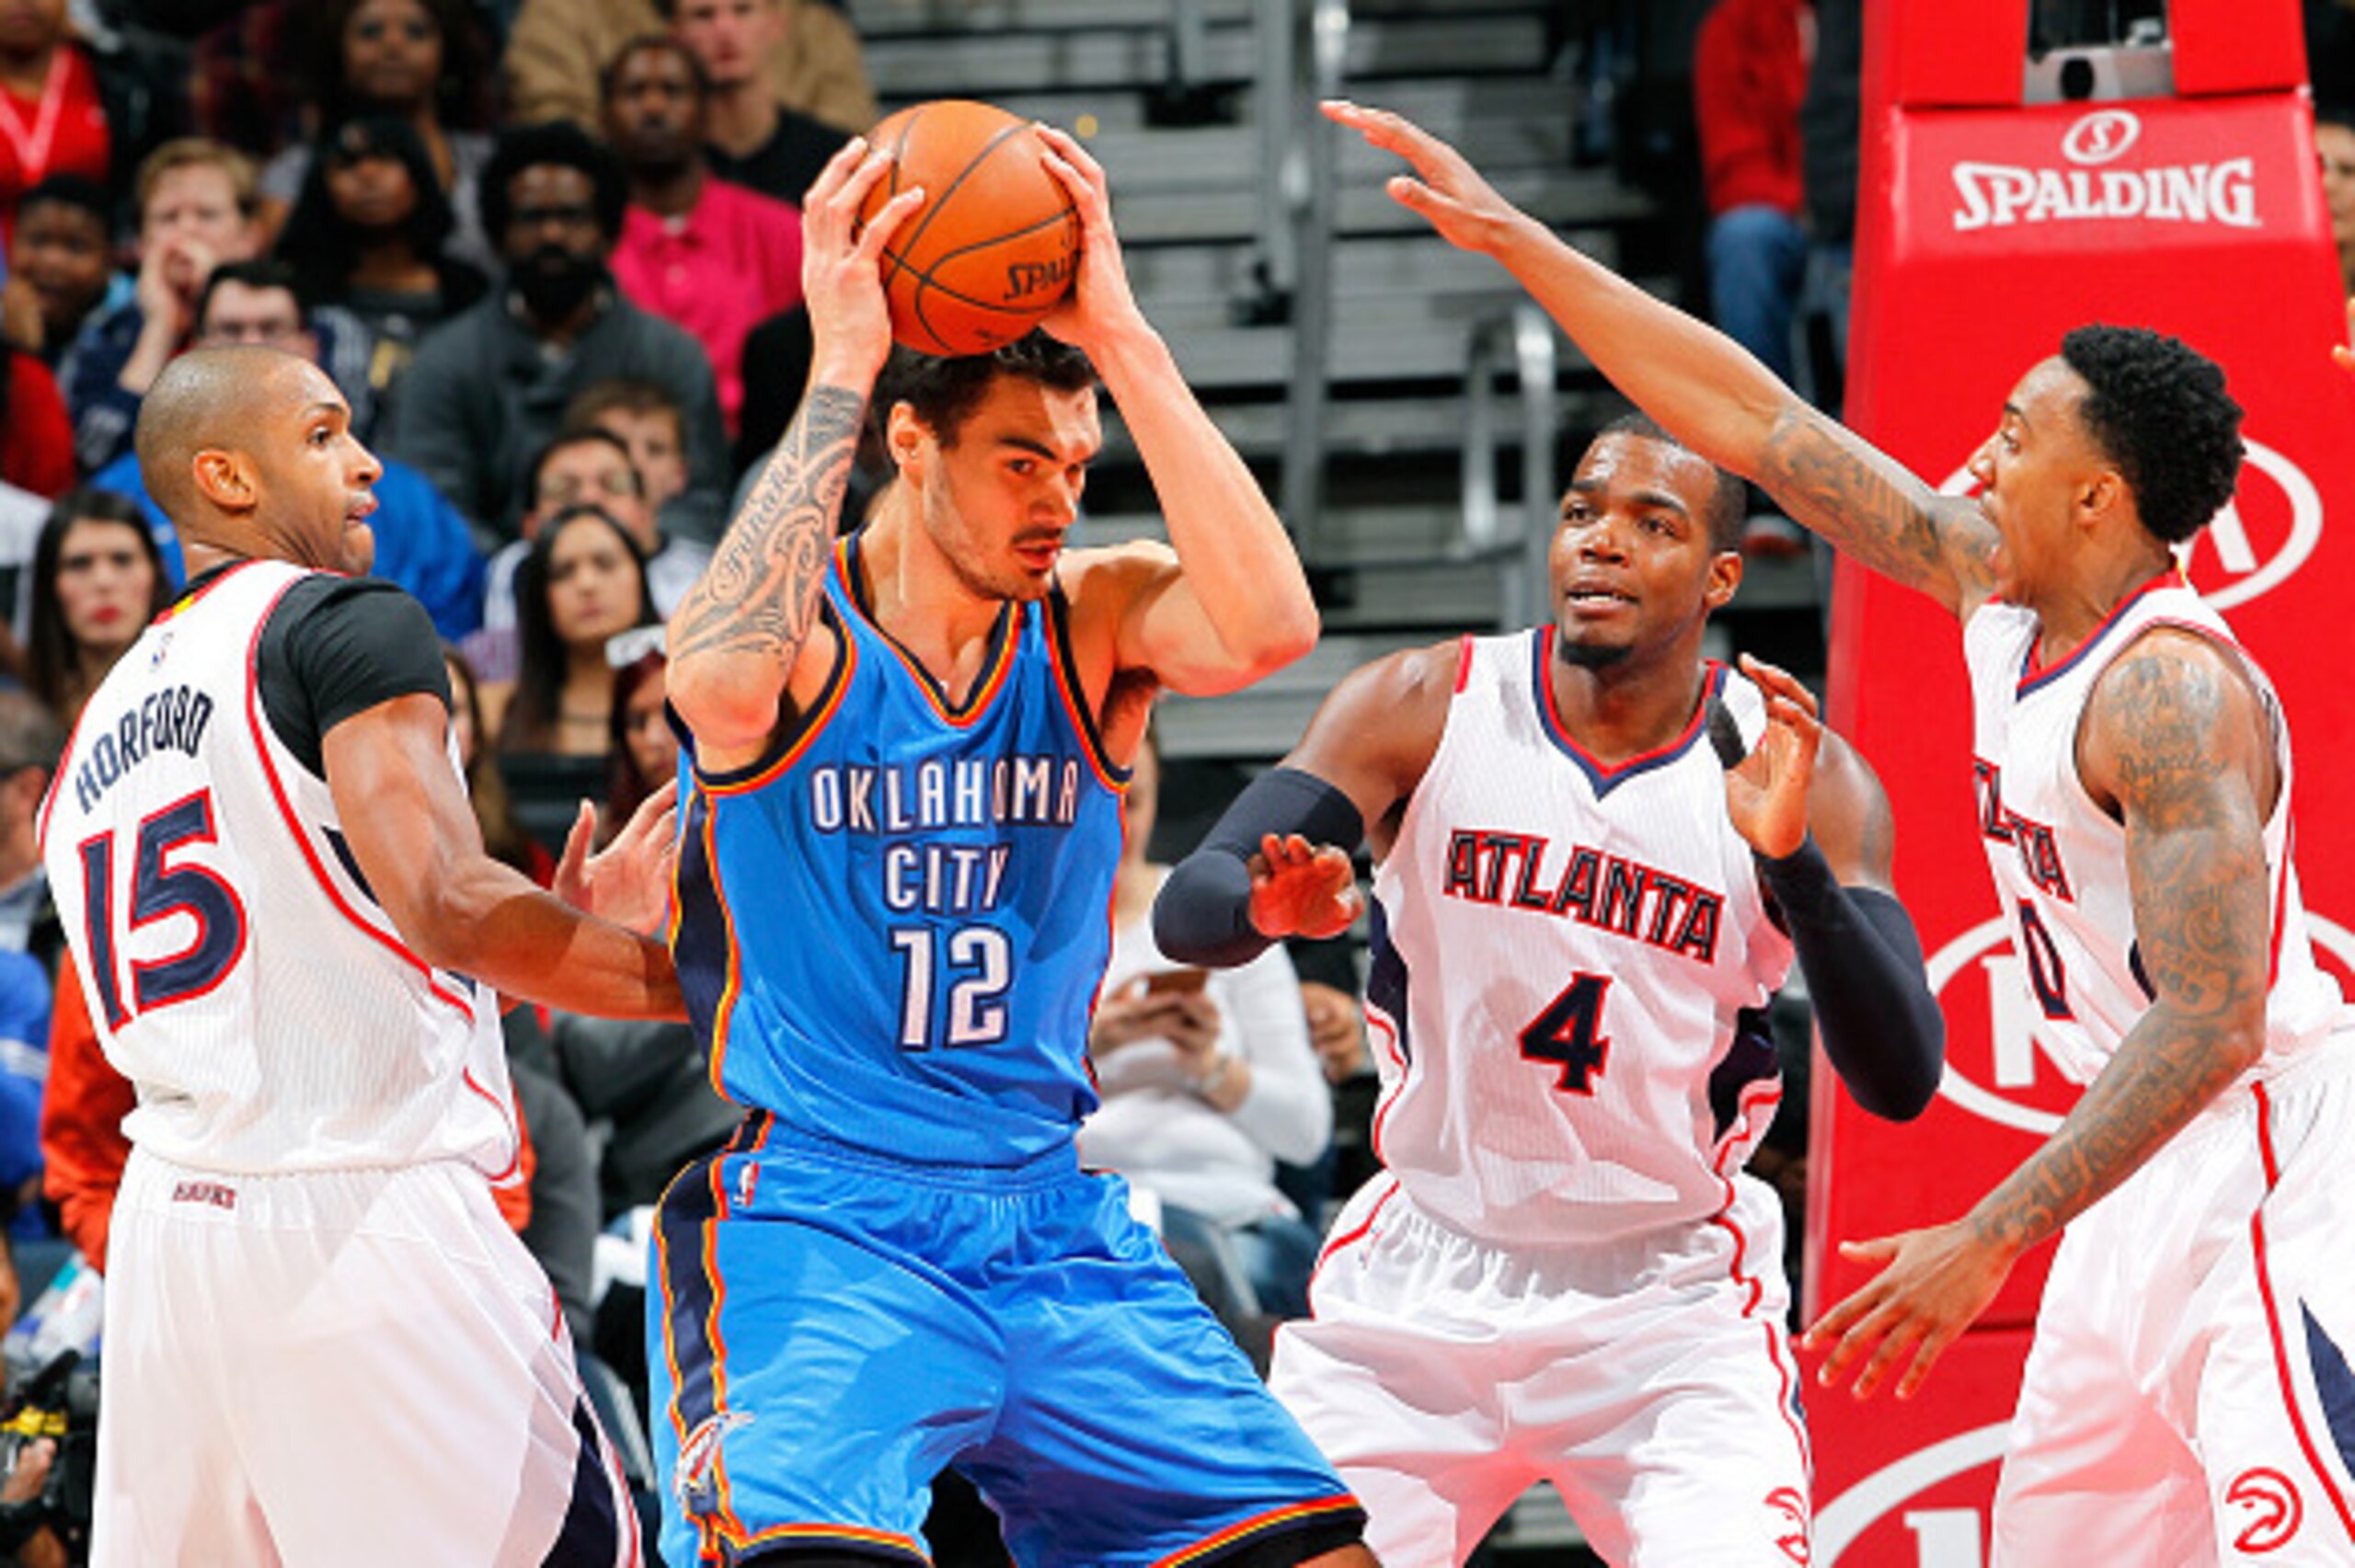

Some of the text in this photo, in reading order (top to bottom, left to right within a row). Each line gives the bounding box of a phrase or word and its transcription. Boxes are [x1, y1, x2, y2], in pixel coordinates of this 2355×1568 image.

[1952, 158, 2263, 231] SPALDING
[1003, 258, 1068, 302] SPAL
[75, 684, 213, 815] HORFORD
[810, 756, 1079, 835] OKLAHOMA
[78, 785, 247, 1036] 15
[883, 840, 1014, 915] CITY
[1443, 828, 1726, 964] ATLANTA
[889, 921, 1014, 1051] 12
[1518, 971, 1614, 1096] 4
